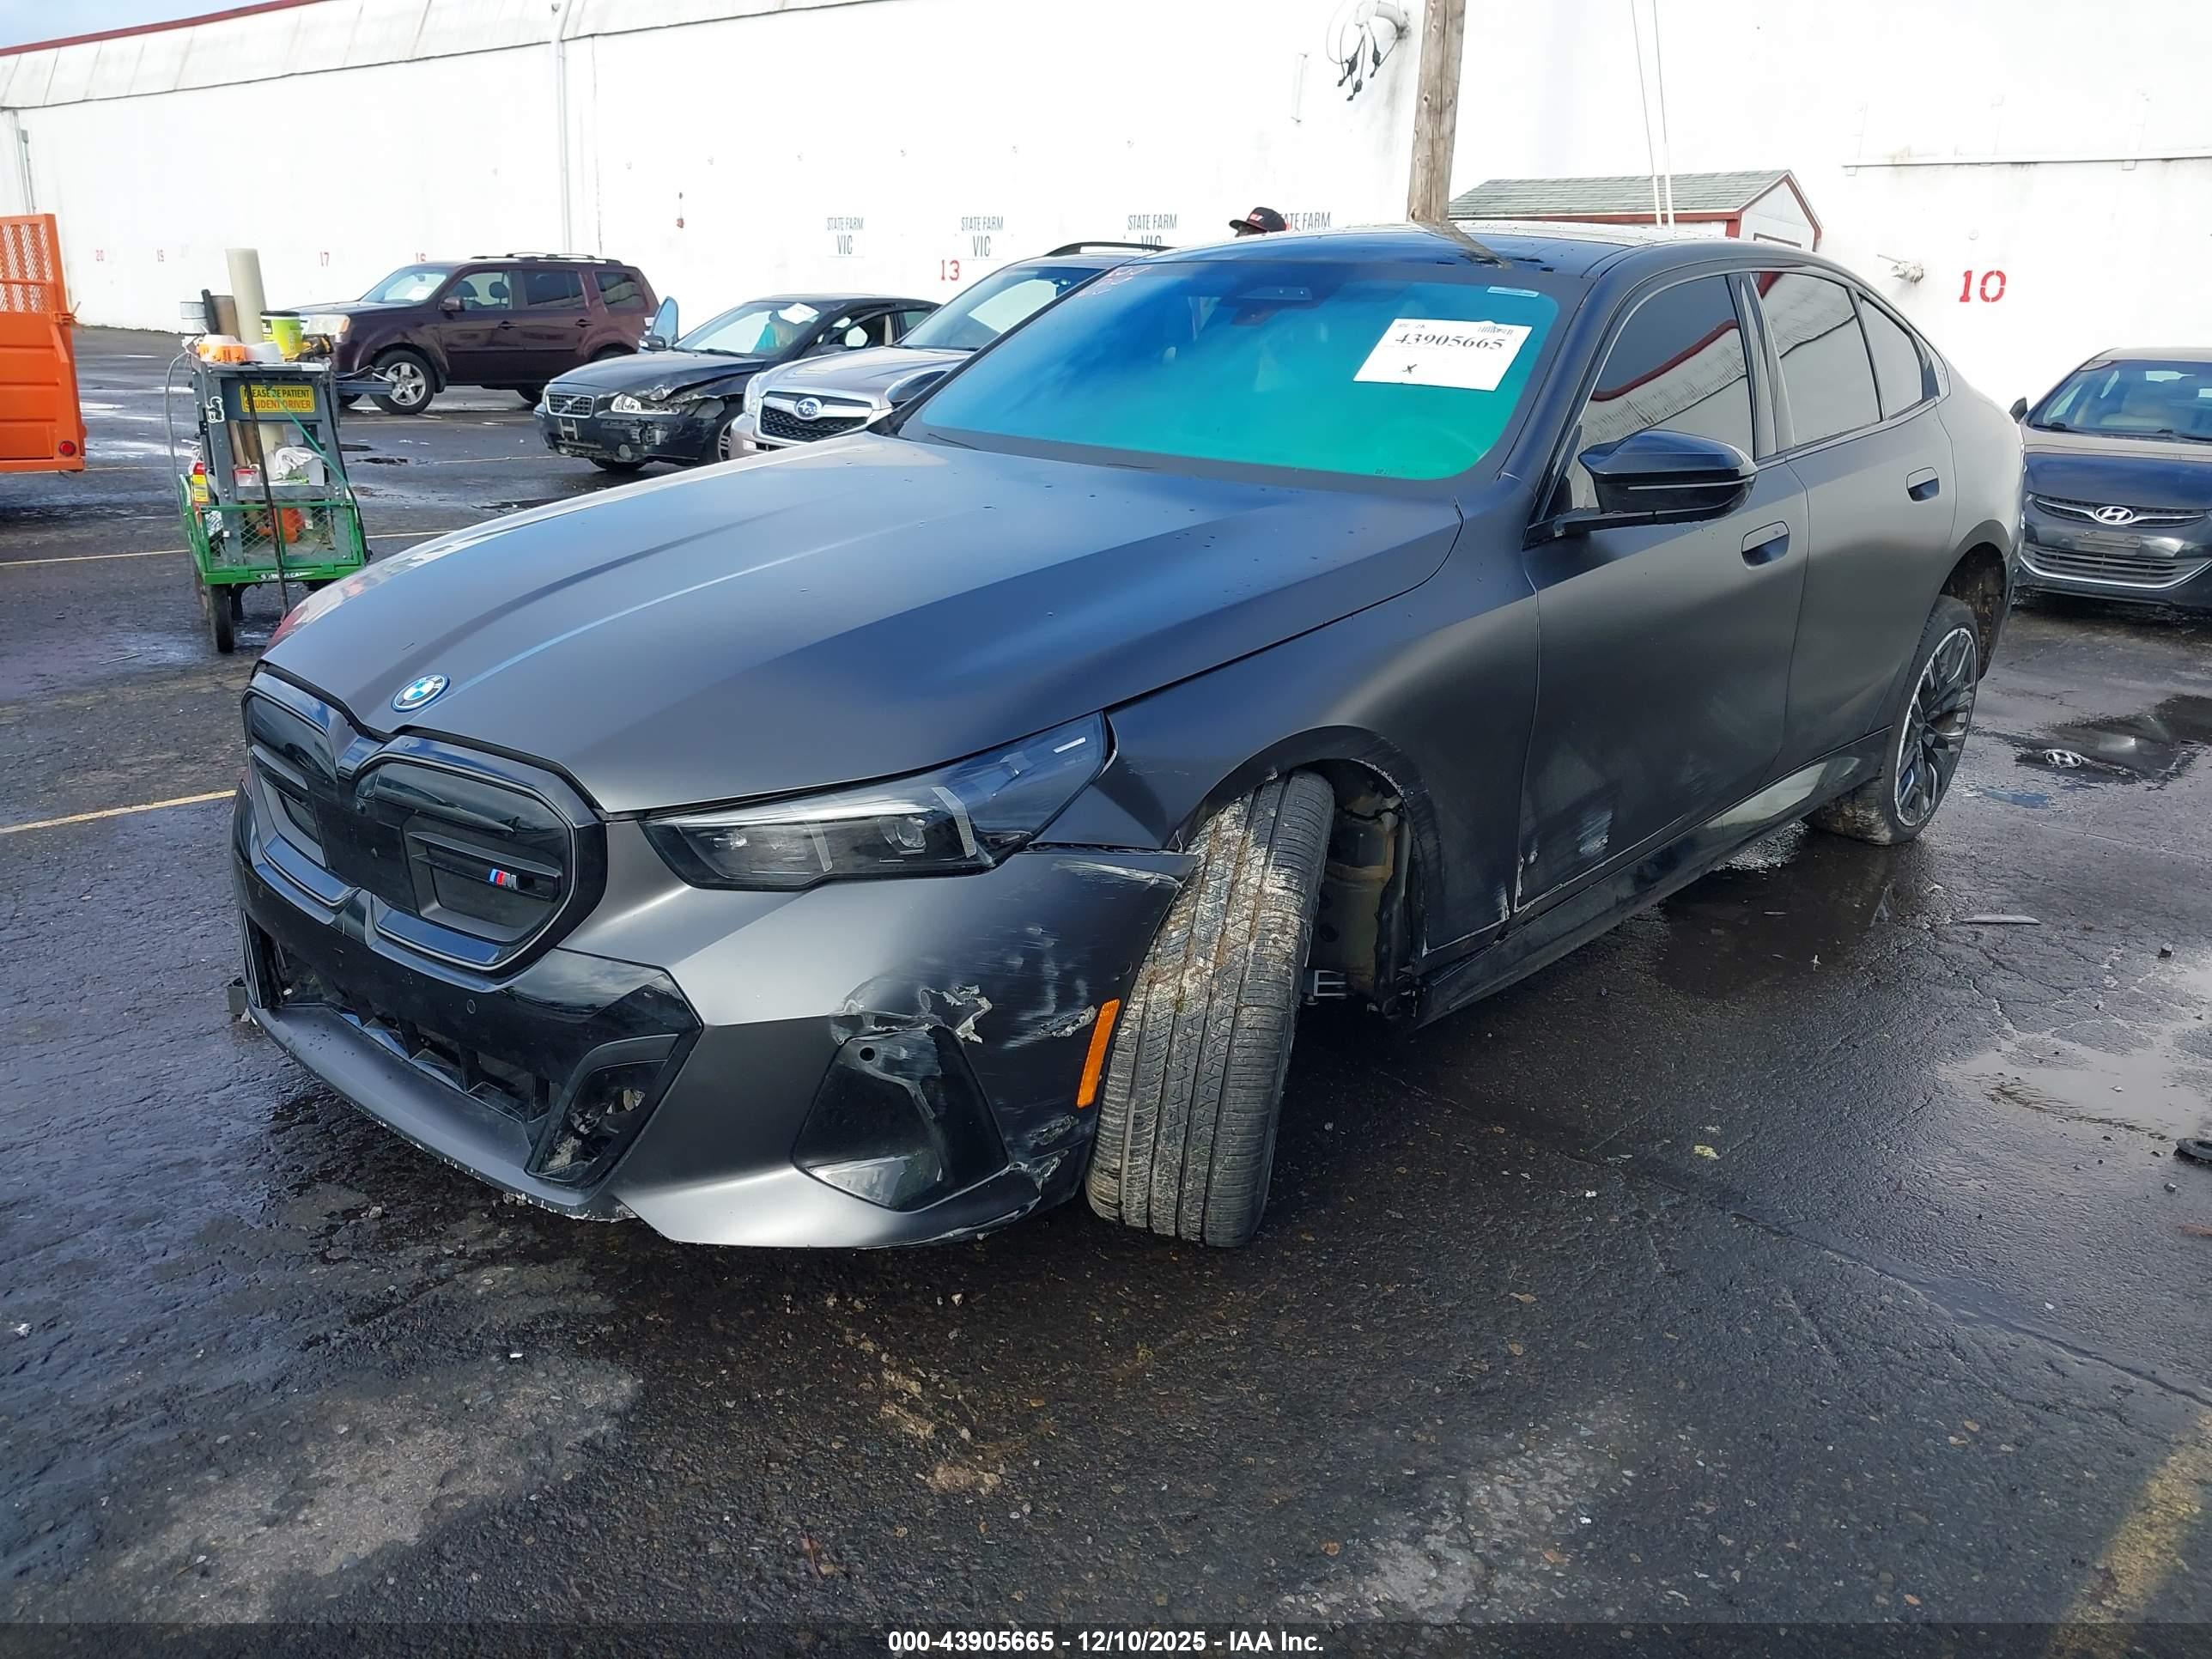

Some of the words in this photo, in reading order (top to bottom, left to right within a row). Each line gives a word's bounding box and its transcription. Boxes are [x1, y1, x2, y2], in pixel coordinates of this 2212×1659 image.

[827, 217, 844, 231] STATE
[846, 217, 864, 231] FARM
[961, 216, 981, 232] STATE
[983, 216, 1003, 231] FARM
[1127, 214, 1151, 230] STATE
[1152, 213, 1177, 230] FARM
[1303, 211, 1331, 231] FARM
[837, 234, 853, 255] VIC
[972, 235, 991, 257] VIC
[319, 252, 330, 267] 17
[941, 259, 960, 281] 13
[1959, 270, 2007, 303] 10
[1395, 333, 1506, 350] 43905665
[244, 389, 272, 398] EASE
[282, 389, 310, 398] PATIENT
[245, 399, 281, 409] SUDENT
